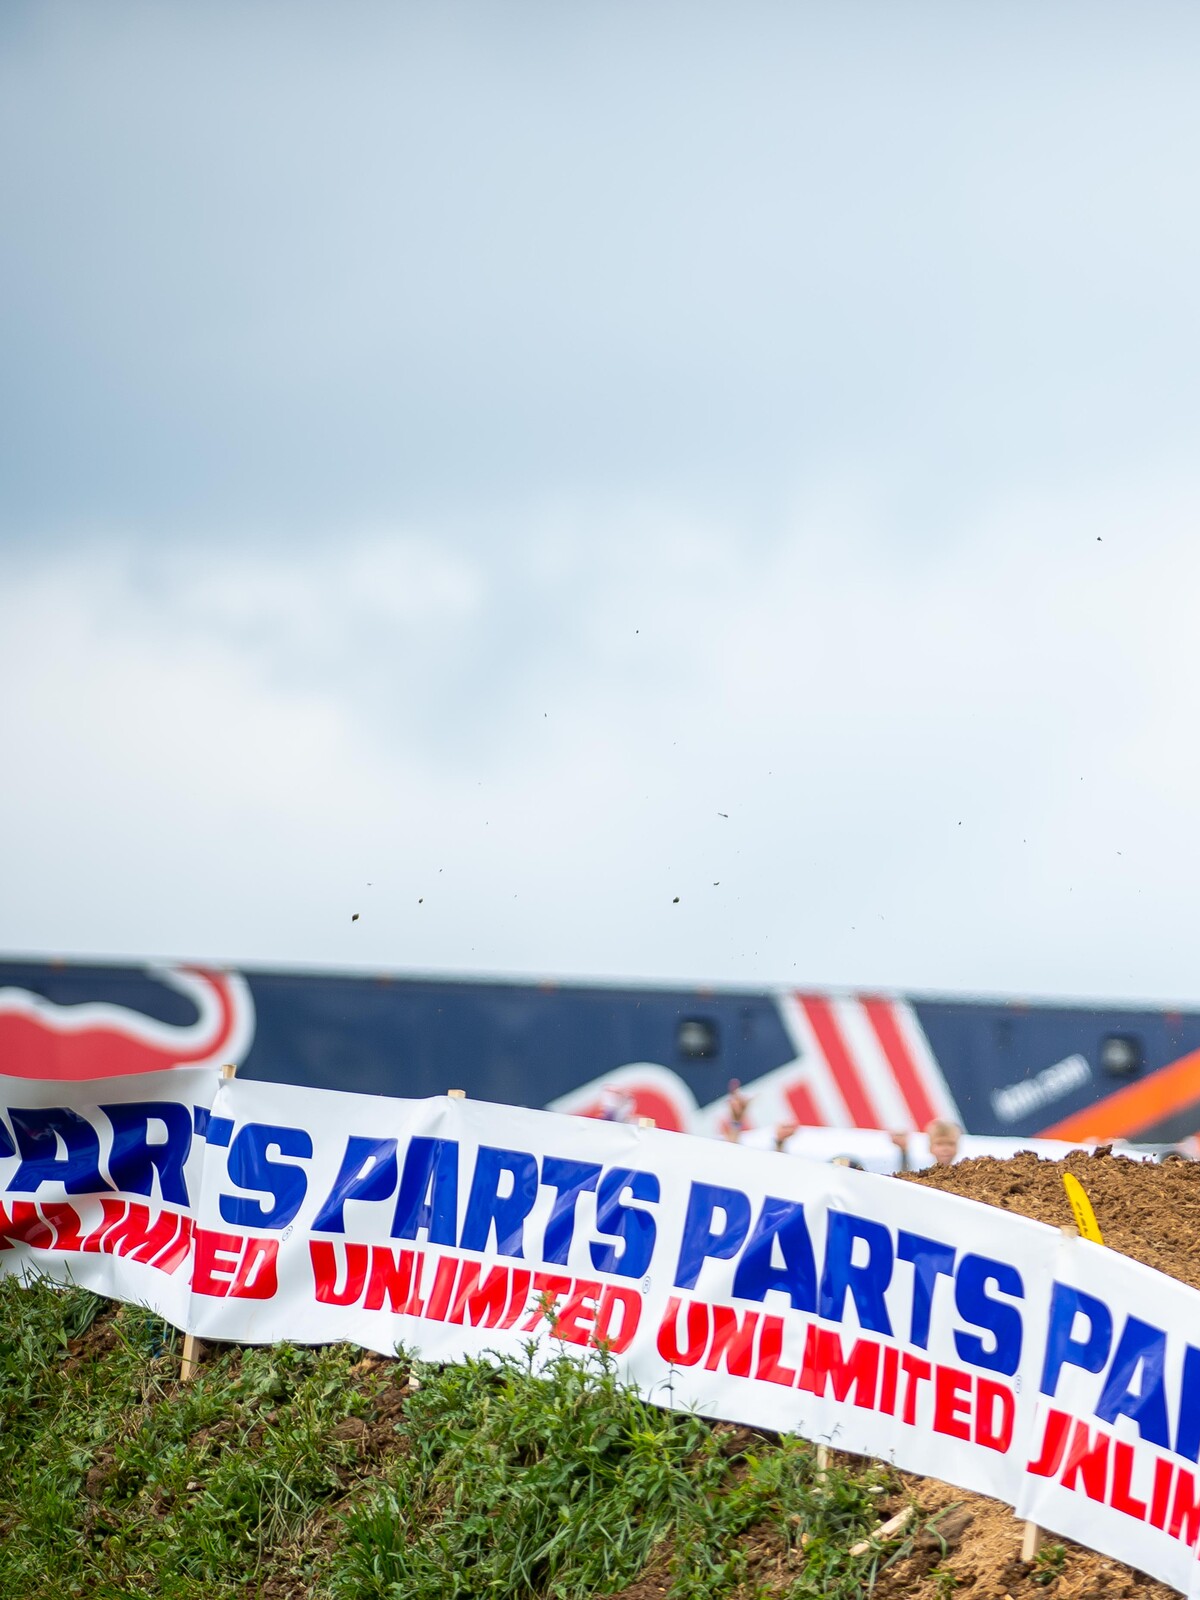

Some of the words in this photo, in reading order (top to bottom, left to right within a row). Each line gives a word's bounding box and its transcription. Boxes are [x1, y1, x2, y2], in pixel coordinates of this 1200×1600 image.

[310, 1135, 661, 1280] PARTS
[673, 1182, 1025, 1377] PARTS
[309, 1239, 643, 1355] UNLIMITED
[657, 1296, 1016, 1455] UNLIMITED
